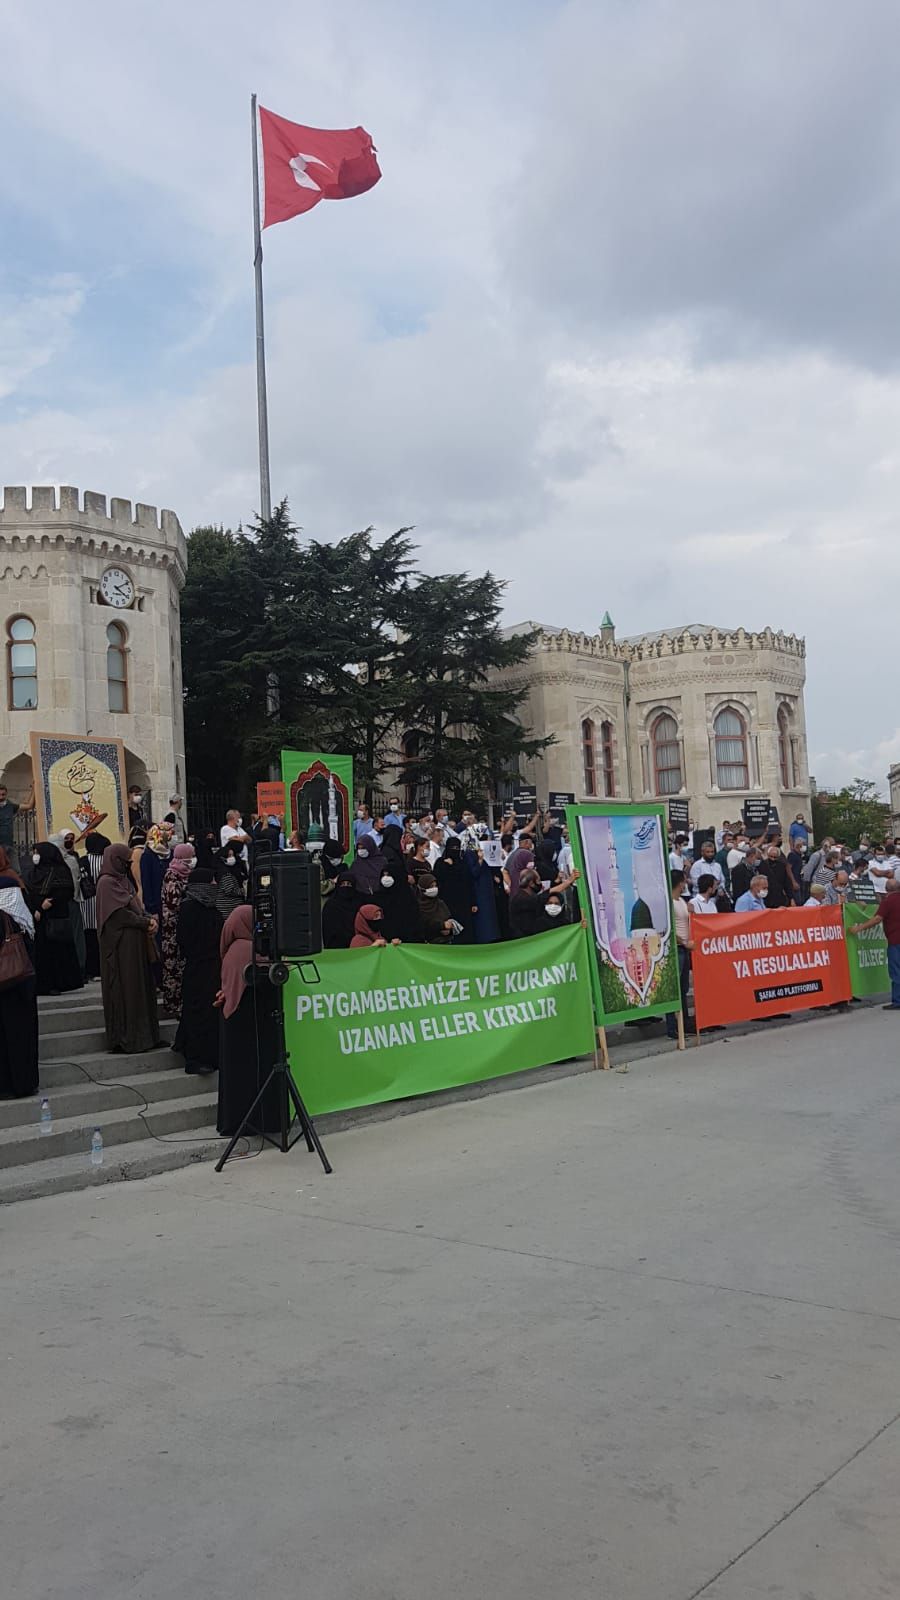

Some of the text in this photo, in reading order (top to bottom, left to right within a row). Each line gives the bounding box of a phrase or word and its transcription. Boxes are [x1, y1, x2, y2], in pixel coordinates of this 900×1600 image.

[701, 931, 773, 955] CANLARIMIZ
[775, 929, 805, 947] SANA
[733, 949, 830, 979] YA RESULALLAH
[296, 962, 577, 1021] PEYGAMBERİMİZE VE KURAN'A
[759, 990, 777, 1002] ŞAFAK
[338, 997, 557, 1054] UZANAN ELLER KIRILIR
